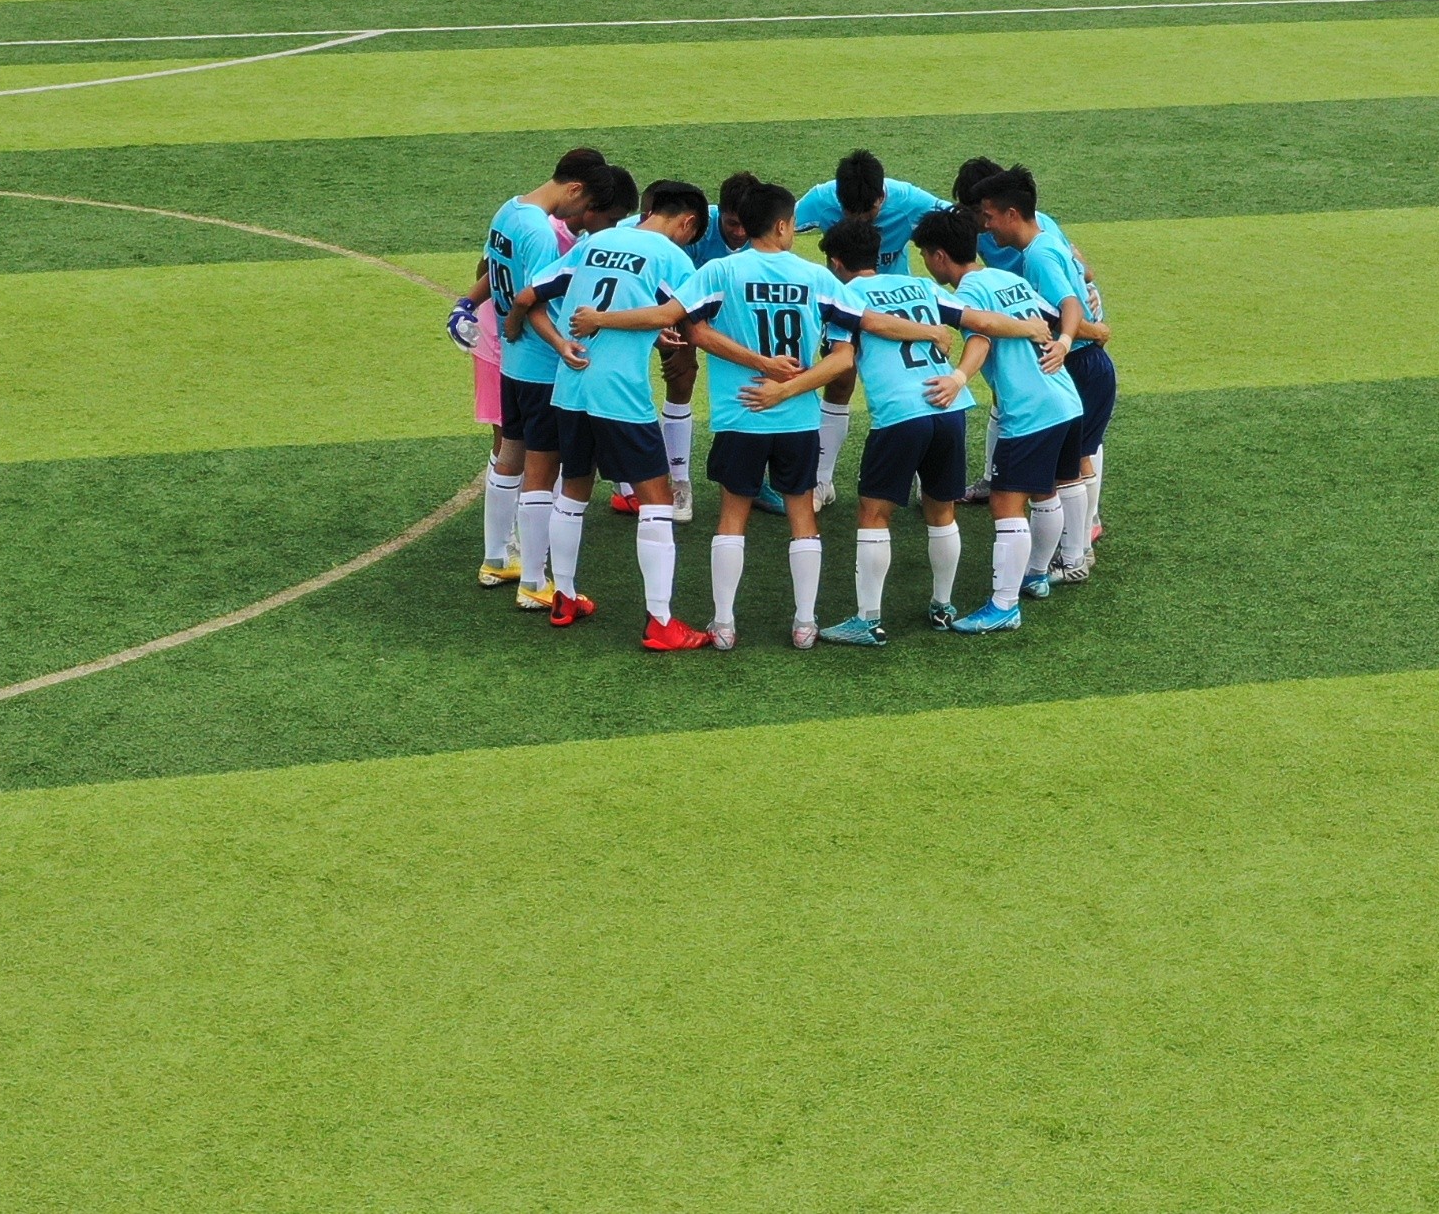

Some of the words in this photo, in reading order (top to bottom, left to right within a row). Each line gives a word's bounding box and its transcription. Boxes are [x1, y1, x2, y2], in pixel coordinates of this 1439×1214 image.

[591, 250, 640, 272] CHK
[753, 283, 802, 303] LHD
[868, 286, 926, 306] HMM
[996, 283, 1031, 307] WZH
[752, 309, 801, 360] 18
